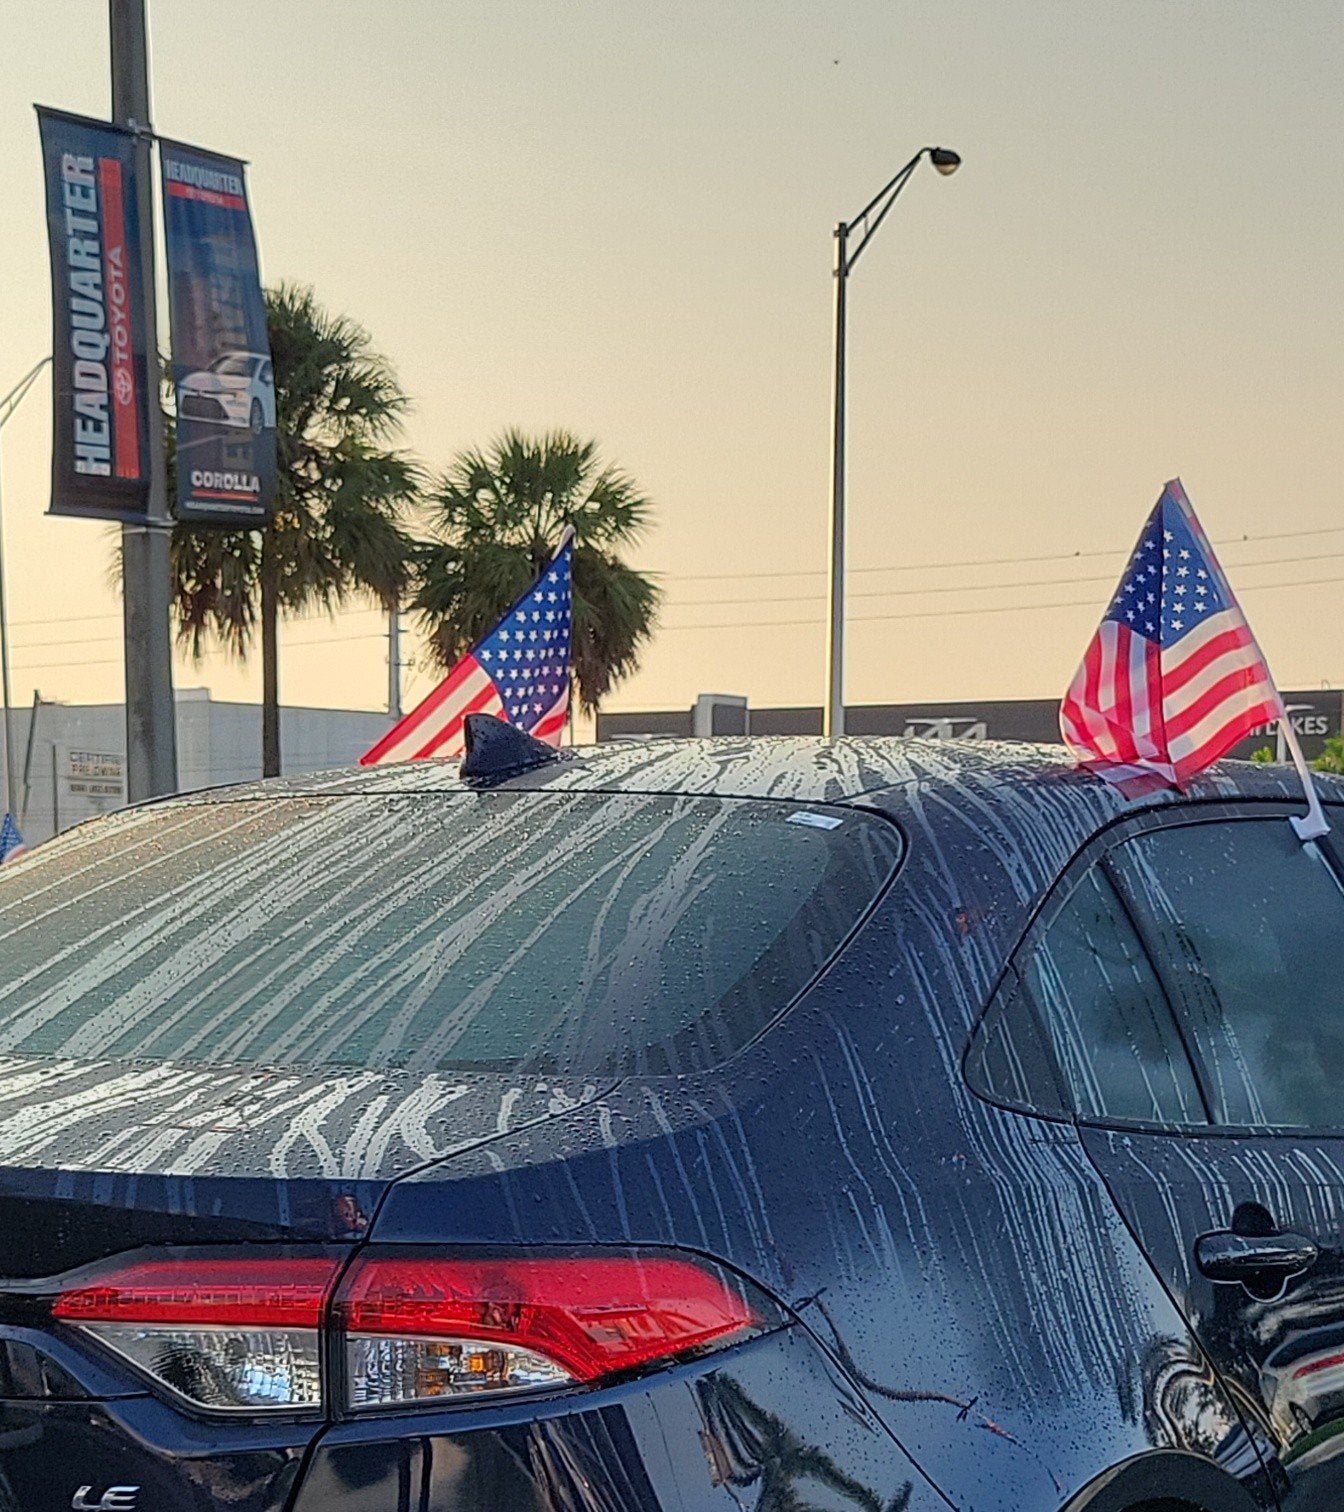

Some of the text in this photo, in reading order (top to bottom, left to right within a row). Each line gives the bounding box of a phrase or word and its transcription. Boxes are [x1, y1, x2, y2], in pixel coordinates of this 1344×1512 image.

[165, 159, 243, 197] HEADQUARTER
[62, 153, 111, 477] HEADQUARTER
[110, 247, 130, 361] TOYOTA
[191, 470, 260, 492] COROLLA
[1265, 716, 1328, 735] LKES
[72, 1485, 140, 1510] LE
